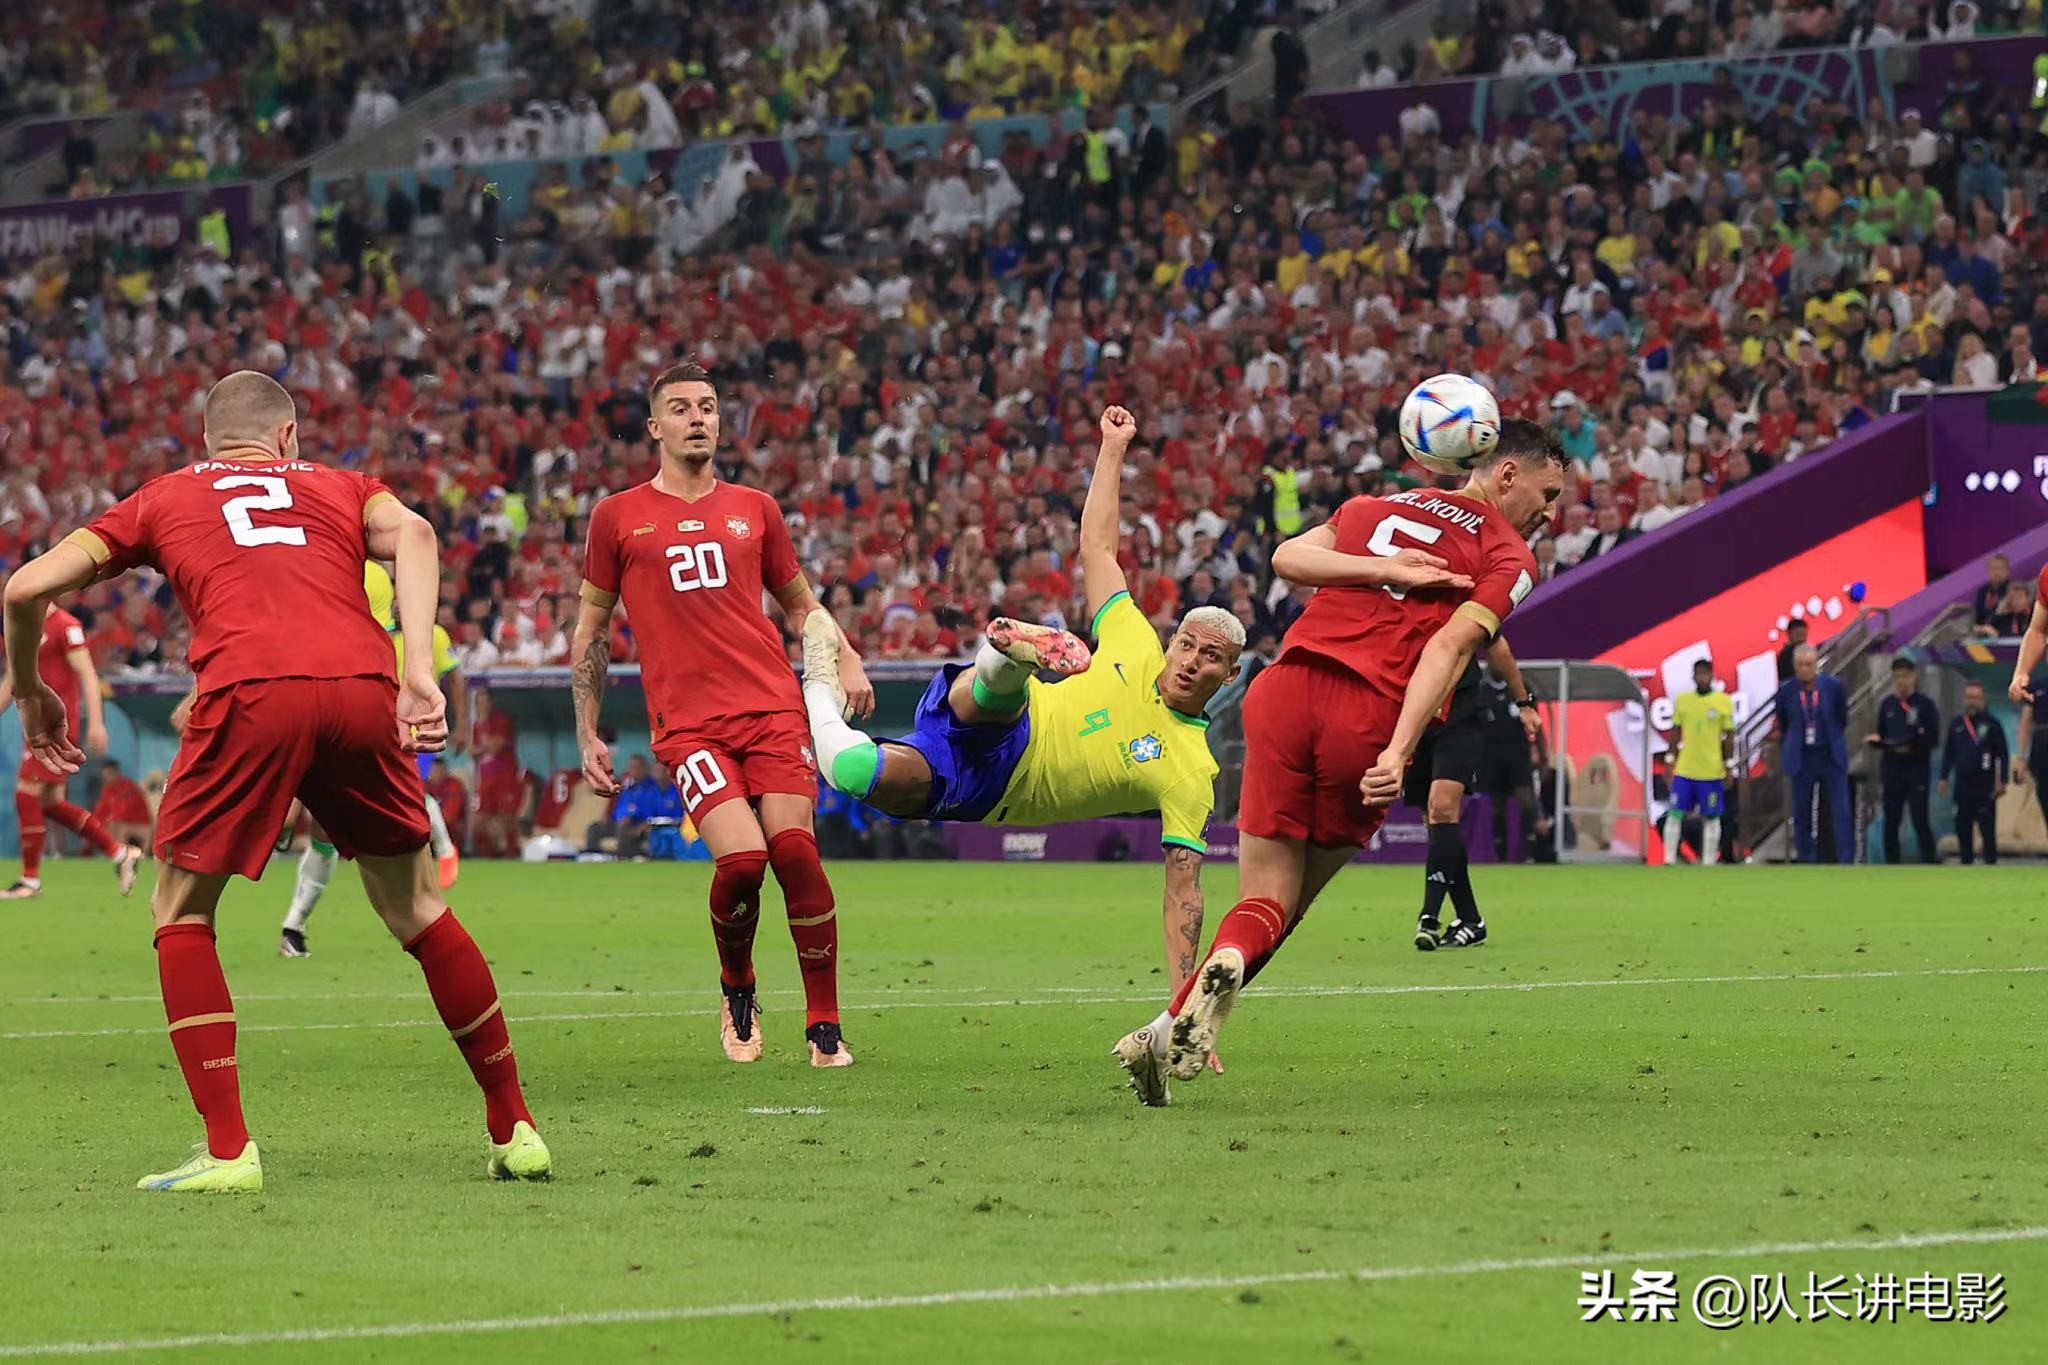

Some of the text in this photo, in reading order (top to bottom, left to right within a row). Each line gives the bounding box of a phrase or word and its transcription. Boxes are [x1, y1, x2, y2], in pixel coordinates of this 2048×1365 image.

[212, 475, 307, 548] 2
[665, 540, 728, 592] 20
[1078, 707, 1112, 737] 9
[676, 748, 728, 813] 20
